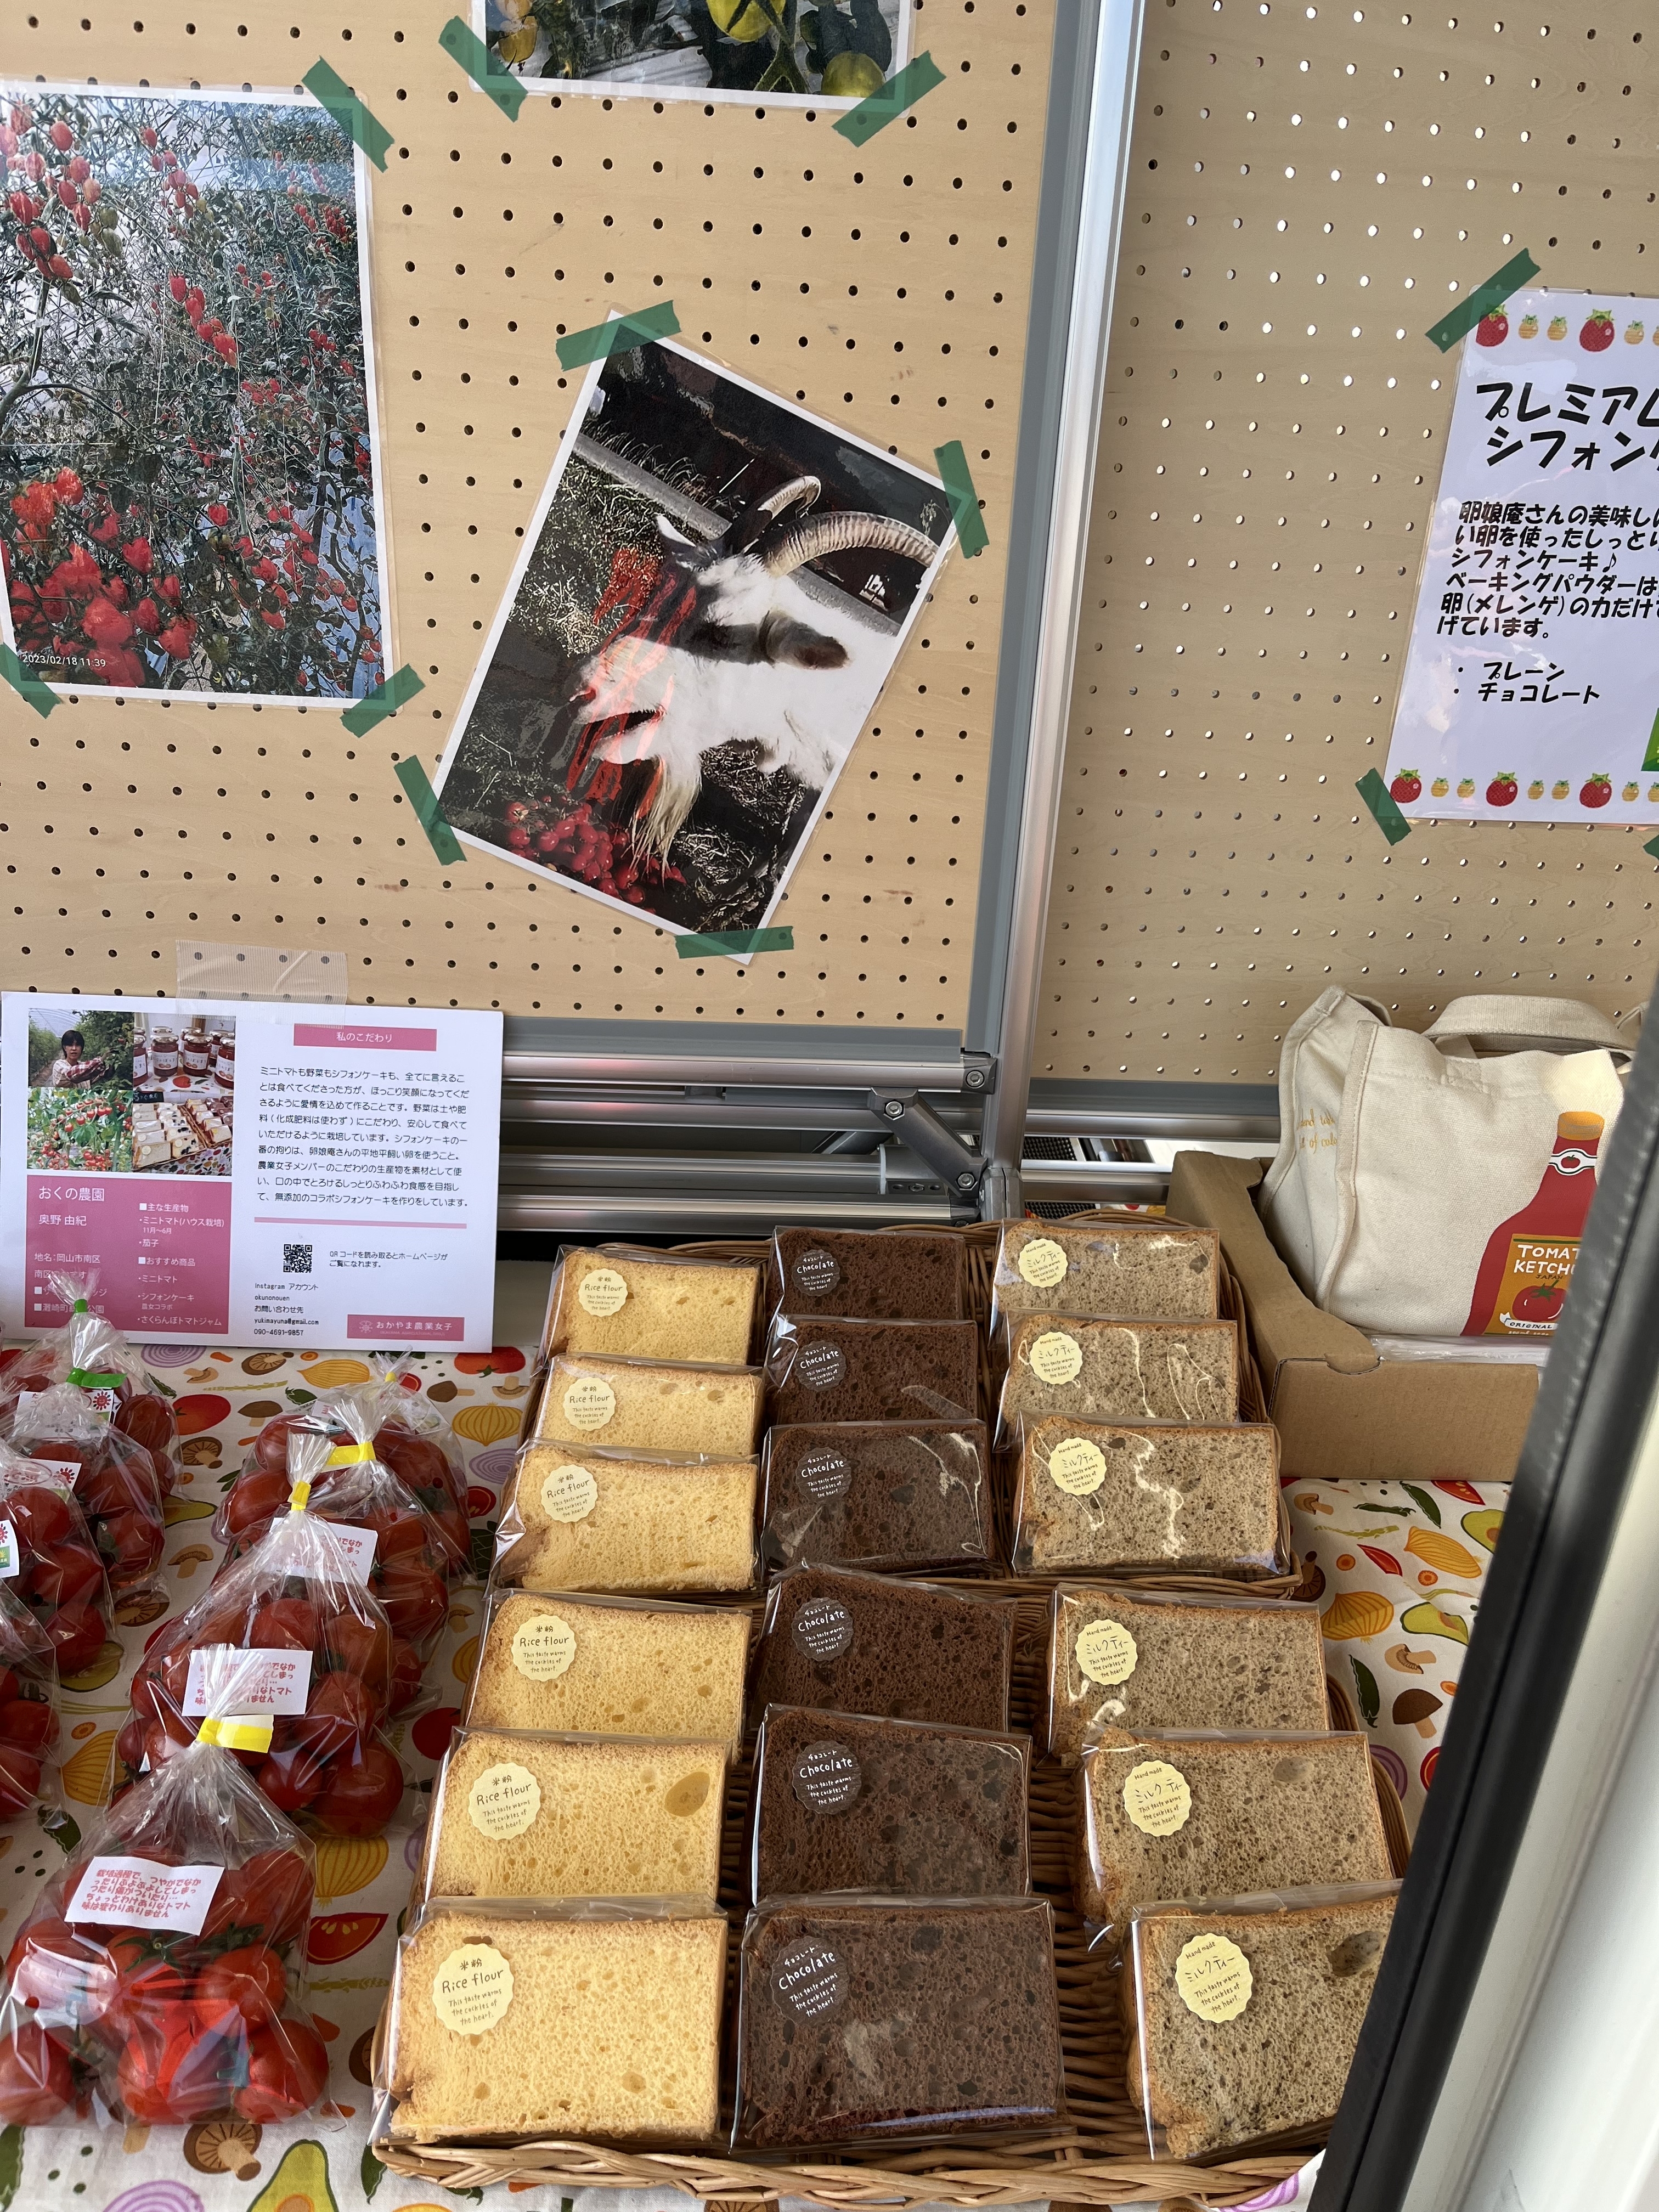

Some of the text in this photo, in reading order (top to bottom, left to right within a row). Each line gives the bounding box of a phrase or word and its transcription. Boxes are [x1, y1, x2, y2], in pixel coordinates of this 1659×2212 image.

[1487, 426, 1659, 472] シフォン
[1459, 500, 1659, 528] 卵娘庵さんの美味し
[1436, 615, 1549, 640] げています。
[22, 654, 106, 667] 2023/02/18 11:39
[336, 1031, 392, 1043] 私のこだわり
[38, 1186, 104, 1201] おくの農園
[147, 1203, 189, 1212] 主な生産物
[38, 1214, 87, 1226] 奥野 由紀
[1517, 1244, 1581, 1259] TOMAT
[146, 1257, 195, 1267] おすすめ商品
[797, 1261, 834, 1273] Chocolate
[1514, 1260, 1575, 1275] KETCH
[141, 1274, 178, 1283] ミニトマト
[141, 1293, 195, 1302] シフォンケーキ
[254, 1305, 304, 1314] お問い合わせ先
[254, 1328, 304, 1336] 090-4691-9857
[376, 1321, 453, 1331] おかやま農業女子
[800, 1351, 839, 1368] Chocolate
[802, 1460, 844, 1477] Chocolate
[547, 1480, 589, 1498] Rice flour
[798, 1611, 844, 1631] Chocolate
[520, 1637, 569, 1647] Rice flour
[800, 1758, 853, 1778] Chocolate
[492, 1775, 512, 1786] 米粉
[1135, 1771, 1148, 1780] Hand
[477, 1784, 531, 1805] Rice flour
[1186, 1941, 1216, 1959] Hand made
[460, 1958, 482, 1971] 米粉
[779, 1953, 835, 1990] Chocolate
[442, 1970, 504, 1993] Rice flour
[789, 1993, 803, 2002] This
[1194, 1989, 1207, 1997] This
[795, 2001, 806, 2010] the
[1201, 1998, 1211, 2006] the
[452, 2008, 462, 2016] the
[806, 2007, 816, 2017] the
[1211, 2005, 1221, 2013] the
